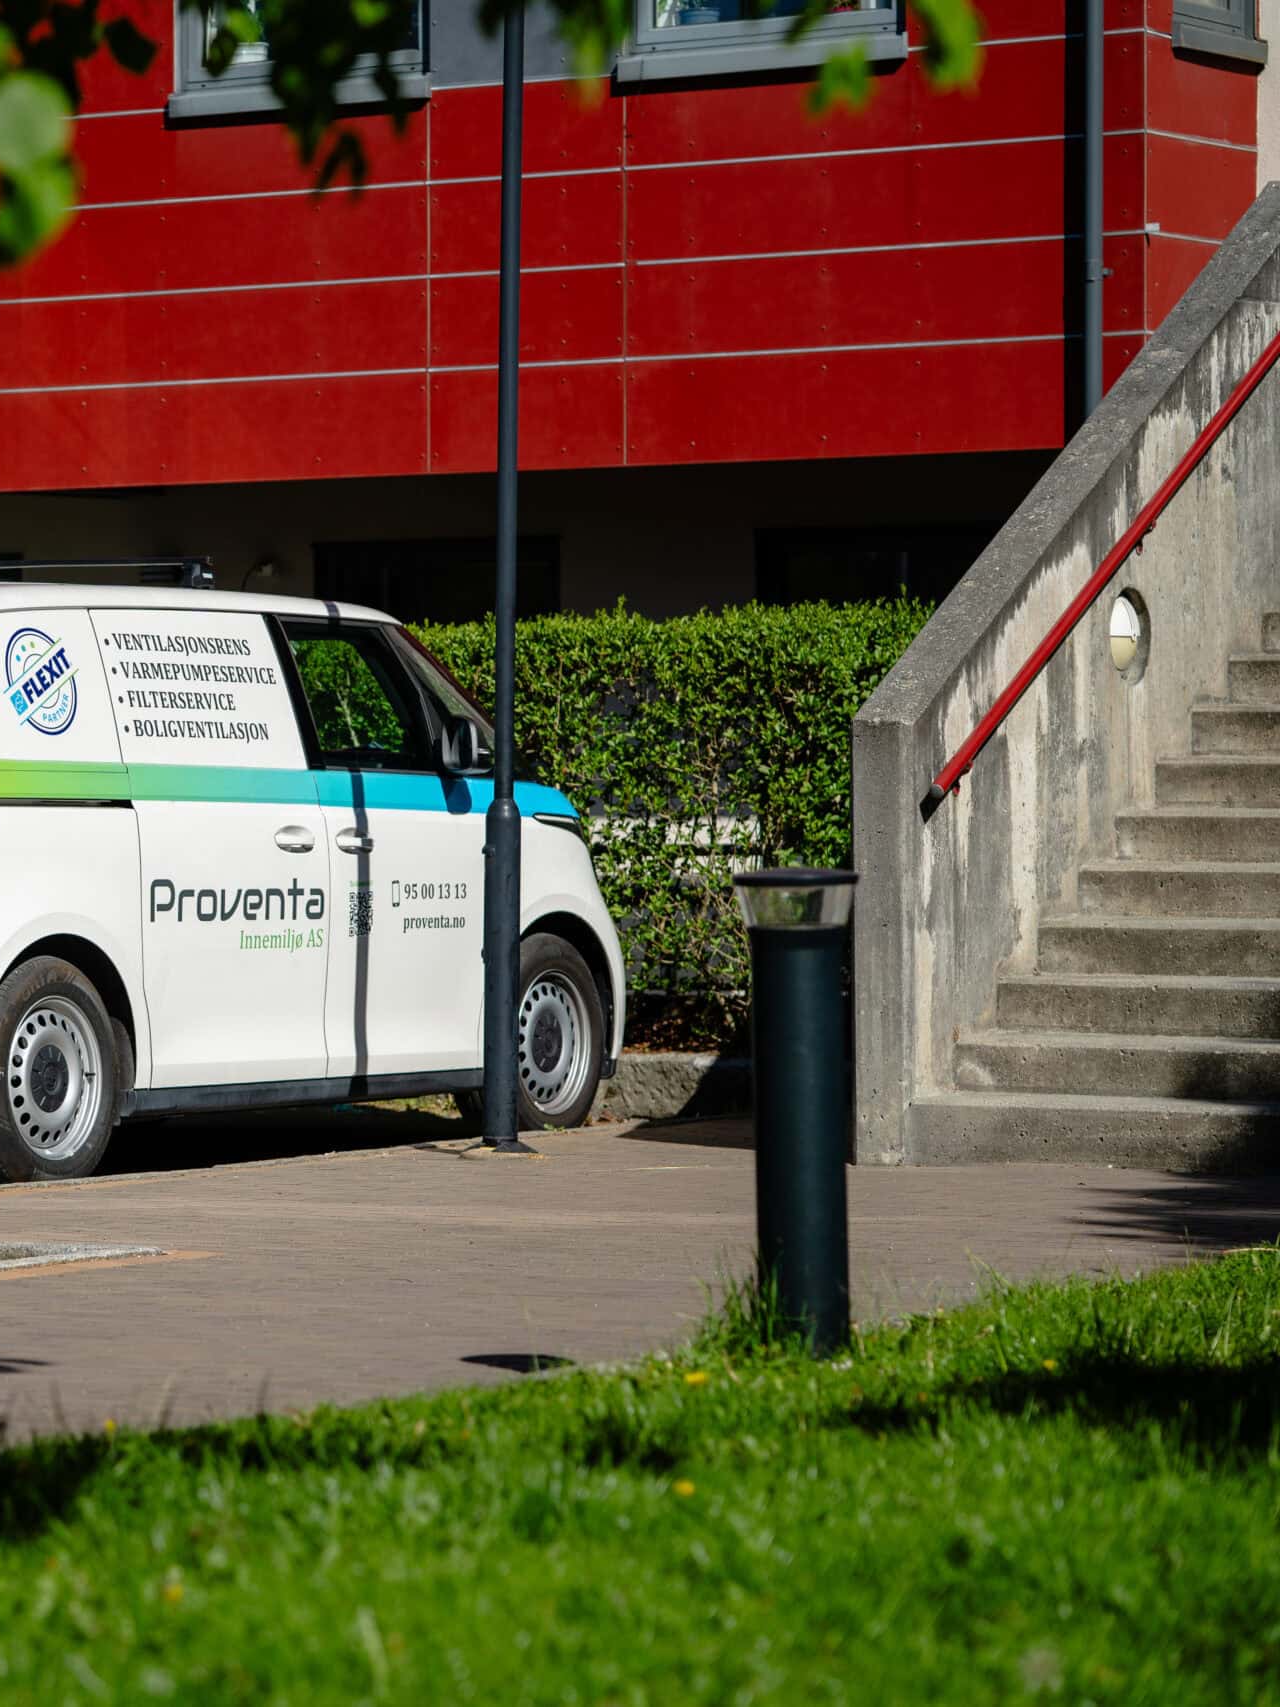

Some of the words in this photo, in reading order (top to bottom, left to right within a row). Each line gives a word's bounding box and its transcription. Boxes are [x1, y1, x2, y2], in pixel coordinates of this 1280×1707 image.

[112, 633, 251, 657] VENTILASJONSRENS
[22, 647, 70, 704] FLEXIT
[120, 661, 276, 685] VARMEPUMPESERVICE
[42, 694, 70, 722] PARTNER
[127, 690, 236, 711] FILTERSERVICE
[134, 720, 270, 743] BOLIGVENTILASJON
[150, 878, 325, 922] Proventa
[404, 883, 418, 899] 95
[421, 883, 435, 899] 00
[438, 883, 451, 899] 13
[454, 883, 467, 899] 13
[403, 914, 466, 934] proventa.no
[240, 929, 303, 953] Innemiljø
[306, 928, 325, 949] AS
